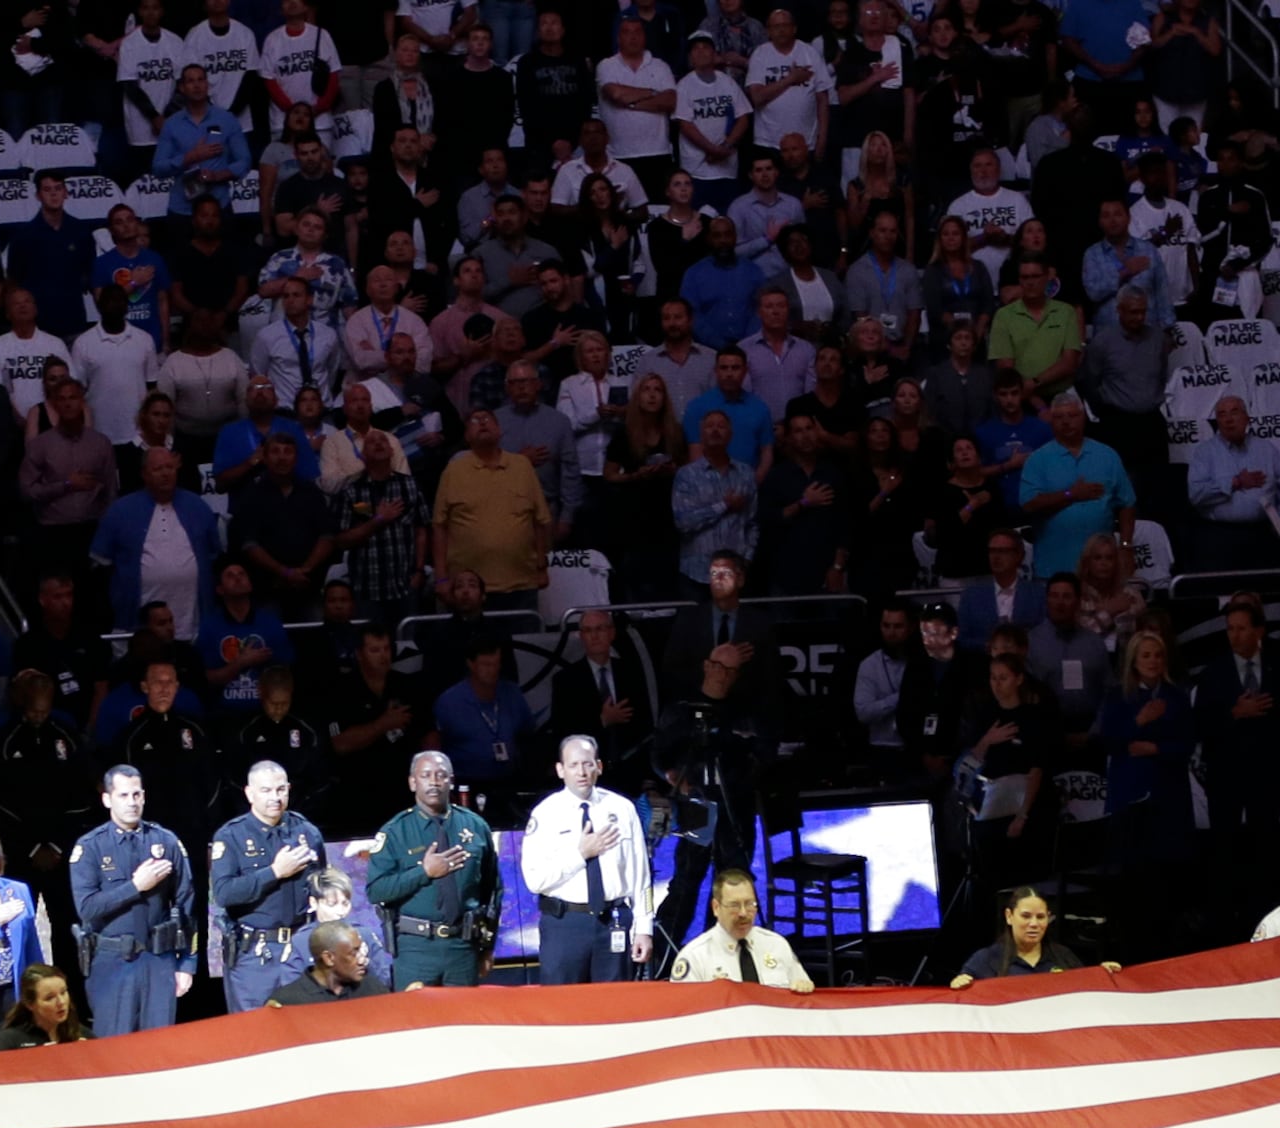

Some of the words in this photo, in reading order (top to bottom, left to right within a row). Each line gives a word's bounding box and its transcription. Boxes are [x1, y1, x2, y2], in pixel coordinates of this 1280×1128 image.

[216, 50, 246, 61] PURE
[204, 59, 247, 73] MAGIC
[45, 124, 78, 135] PURE
[30, 133, 79, 146] MAGIC
[78, 177, 113, 188] PURE
[982, 206, 1016, 217] PURE
[1229, 322, 1261, 333] PURE
[1215, 332, 1262, 346] MAGIC
[614, 346, 646, 364] PURE
[1182, 371, 1232, 388] MAGIC
